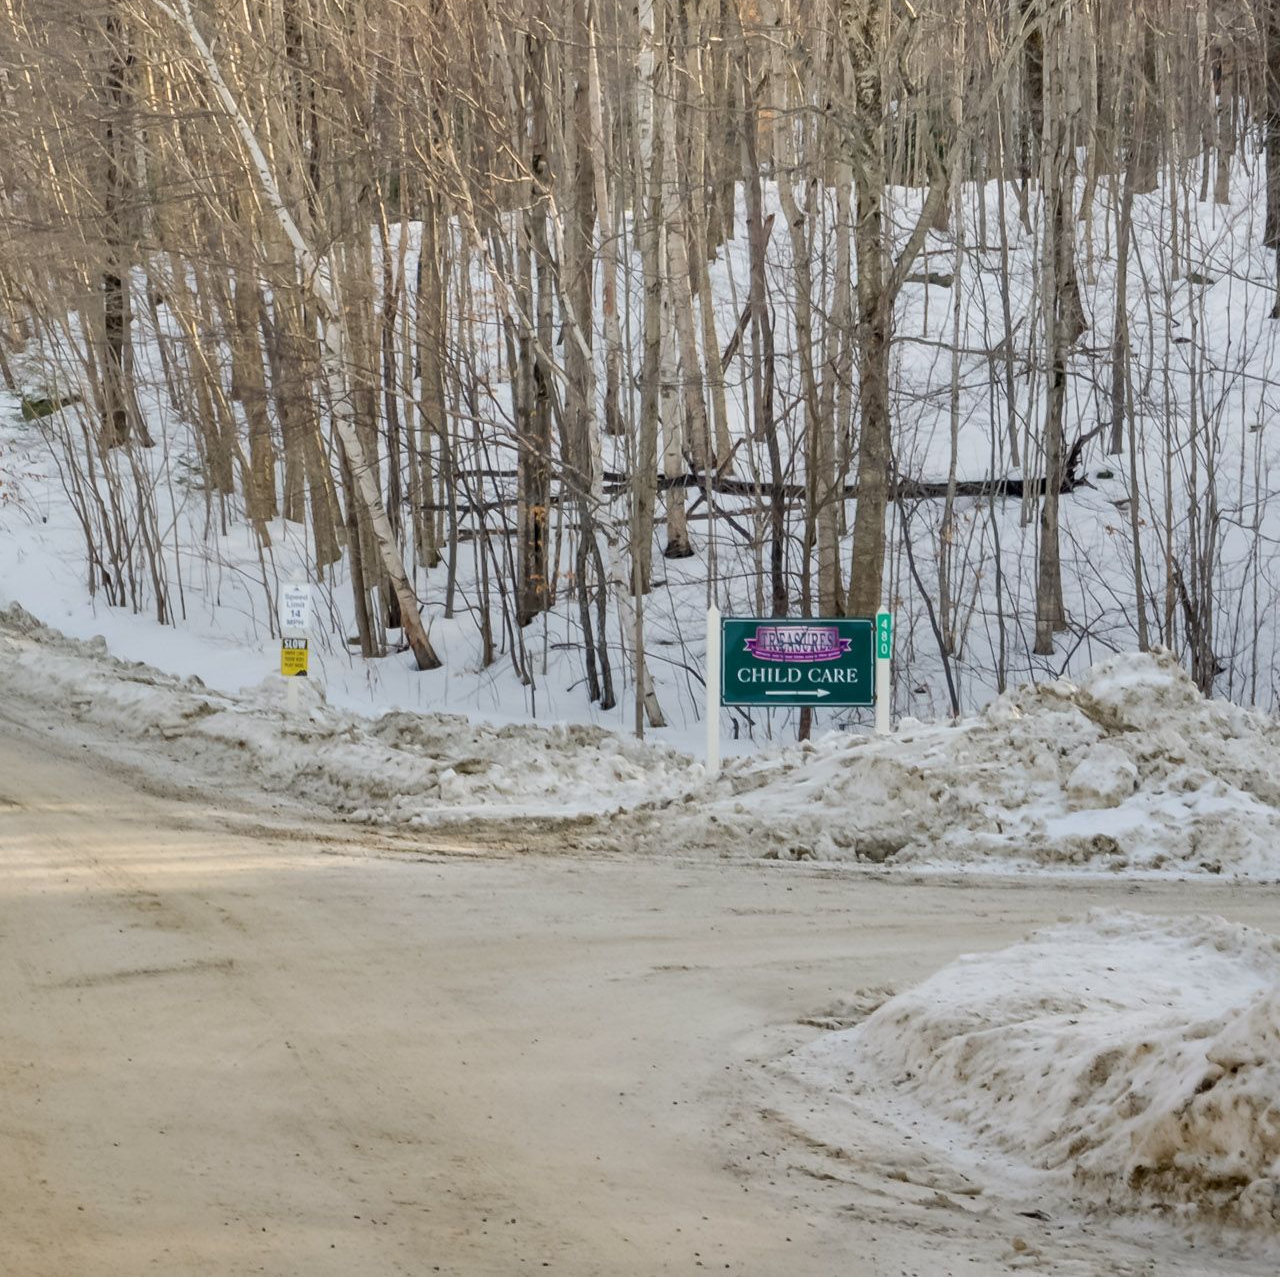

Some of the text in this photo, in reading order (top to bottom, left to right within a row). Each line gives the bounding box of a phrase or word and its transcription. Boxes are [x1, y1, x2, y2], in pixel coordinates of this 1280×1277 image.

[284, 639, 306, 649] SLOW
[760, 632, 834, 652] TREASURES
[737, 667, 858, 683] CHILD CARE
